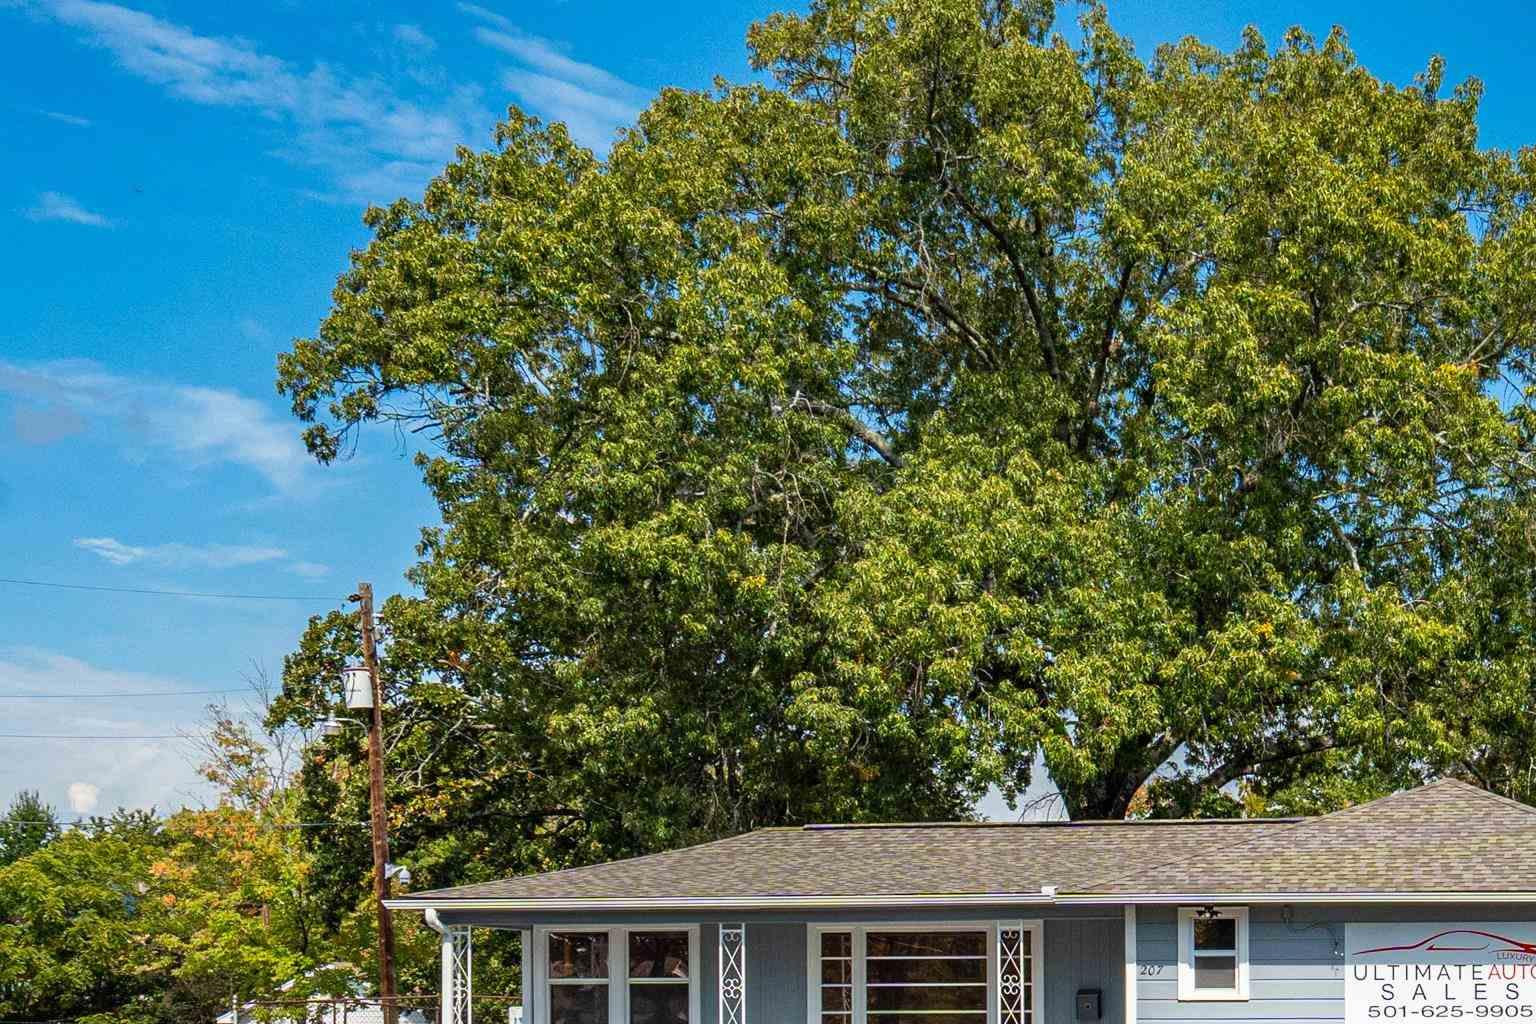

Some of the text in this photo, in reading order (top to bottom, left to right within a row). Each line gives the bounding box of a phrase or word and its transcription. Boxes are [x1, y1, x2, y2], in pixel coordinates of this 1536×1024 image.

[1496, 952, 1535, 962] LUXURY
[1140, 965, 1164, 976] 207
[1381, 983, 1520, 1001] SALES
[1367, 1005, 1533, 1018] 501-625-9905
